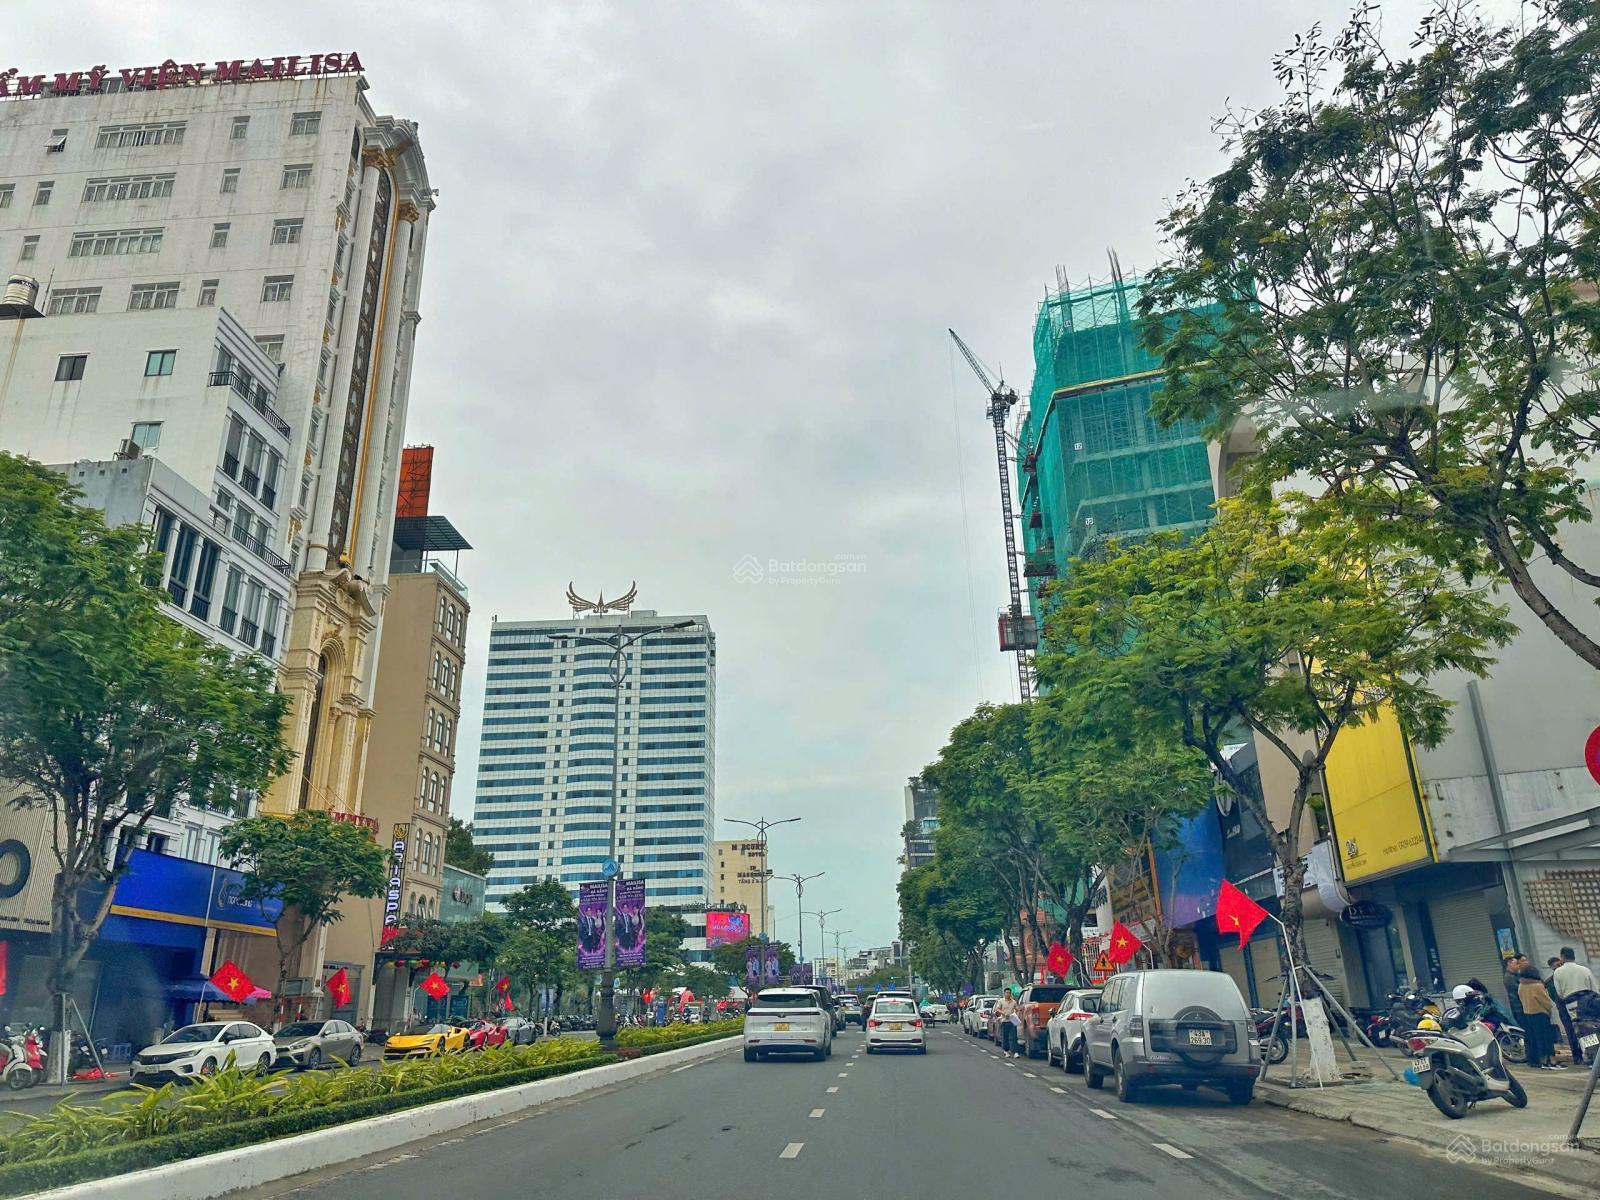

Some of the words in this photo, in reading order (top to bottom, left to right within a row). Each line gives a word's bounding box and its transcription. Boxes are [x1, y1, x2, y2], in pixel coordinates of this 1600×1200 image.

[49, 64, 110, 93] MỸ
[118, 58, 206, 90] VIỆN
[211, 51, 365, 82] MAILISA
